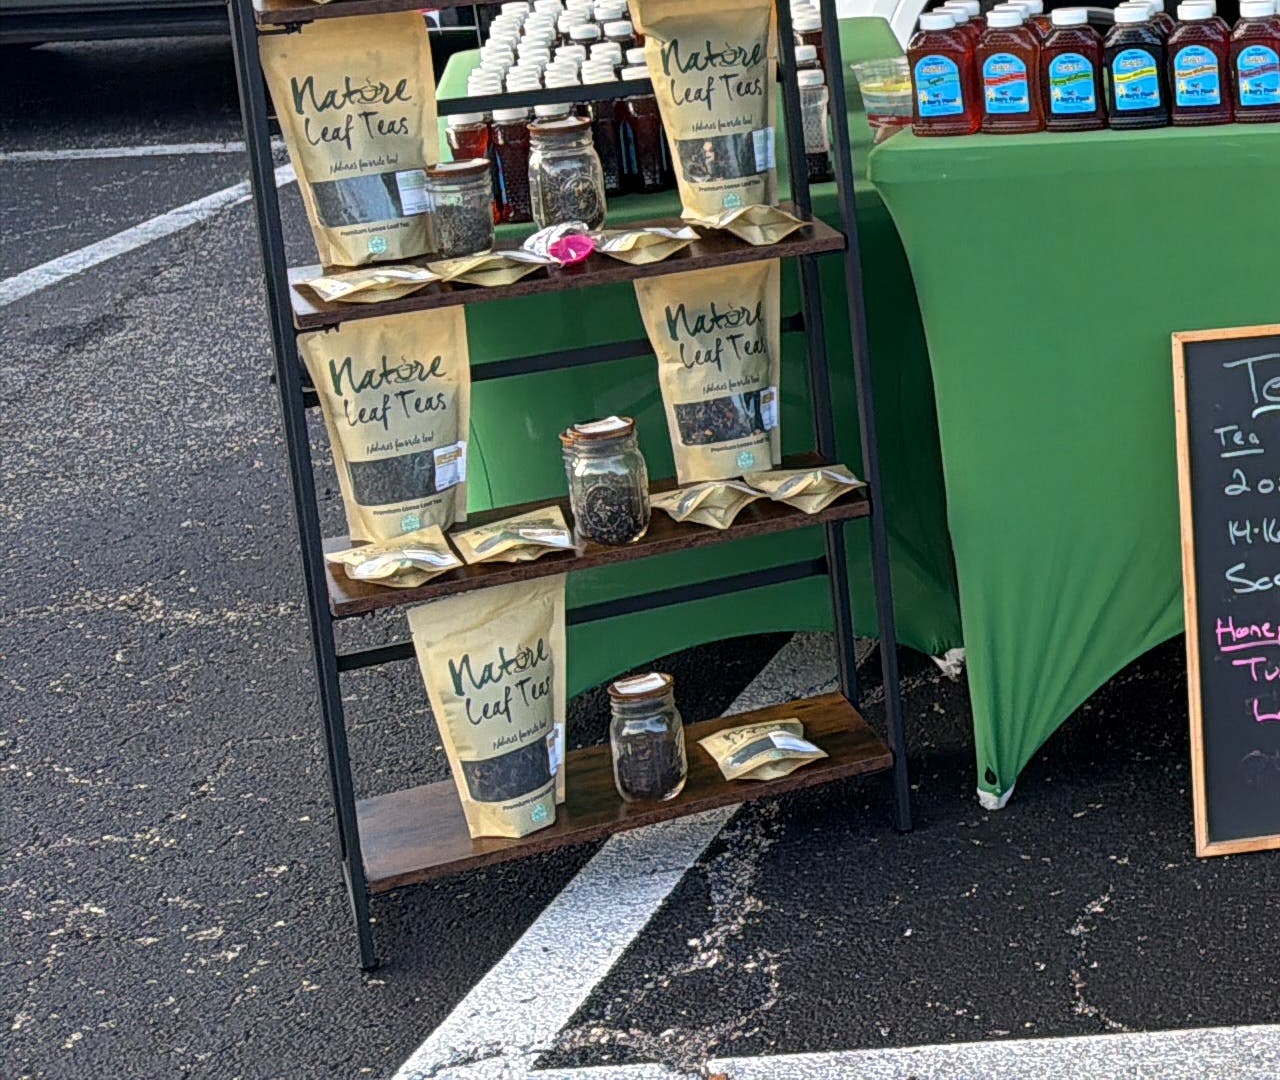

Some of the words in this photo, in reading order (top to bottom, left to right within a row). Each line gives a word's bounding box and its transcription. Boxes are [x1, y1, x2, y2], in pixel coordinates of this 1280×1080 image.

[662, 39, 761, 76] Nature
[291, 76, 412, 115] Nature
[671, 77, 716, 110] Leaf
[720, 73, 762, 101] Teas
[304, 115, 354, 150] Leaf
[358, 112, 408, 139] Teas
[680, 338, 723, 372] Leaf
[329, 356, 447, 396] Nature
[344, 395, 391, 430] Leaf
[395, 390, 447, 419] Teas
[1214, 425, 1259, 445] Tea
[448, 638, 548, 696] Nature
[466, 686, 512, 725] Leaf
